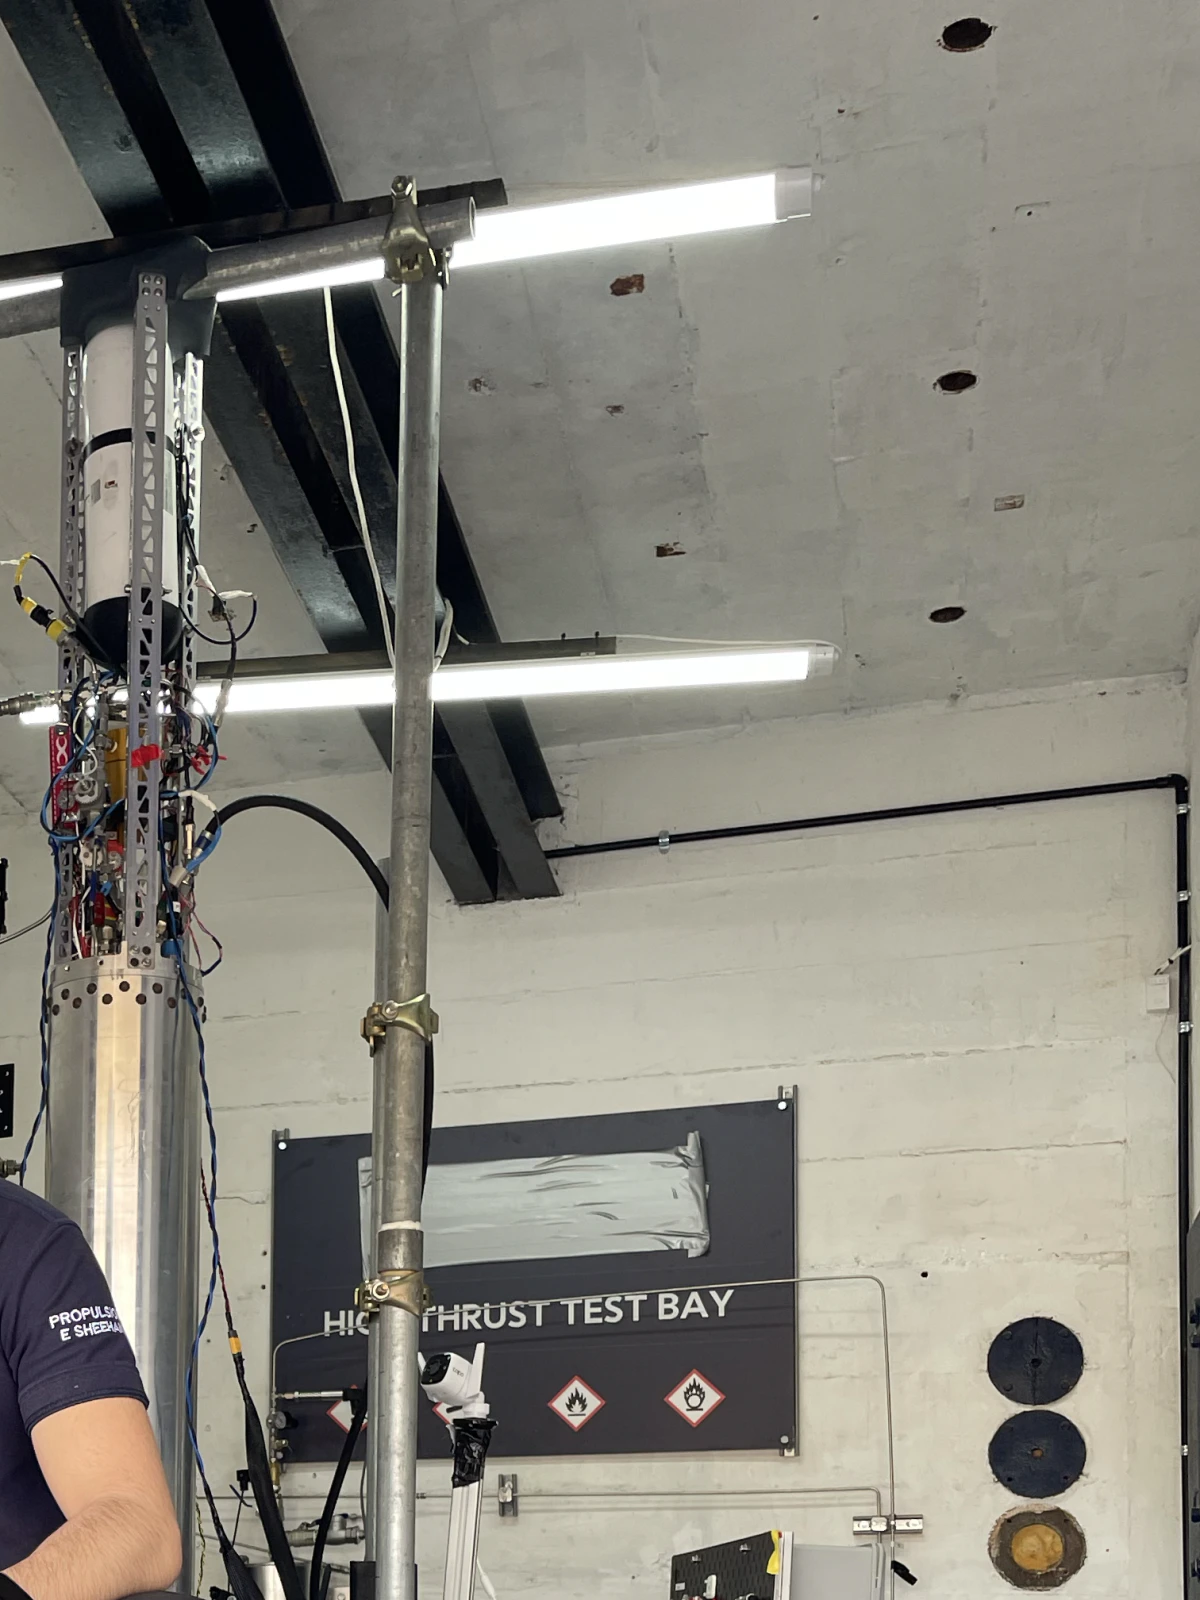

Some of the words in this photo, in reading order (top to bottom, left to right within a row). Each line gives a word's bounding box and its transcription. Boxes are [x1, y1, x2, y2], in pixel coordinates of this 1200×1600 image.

[324, 1310, 369, 1336] HI
[421, 1300, 551, 1332] THRUST
[560, 1294, 647, 1325] TEST
[658, 1289, 734, 1320] BAY
[60, 1327, 71, 1341] E
